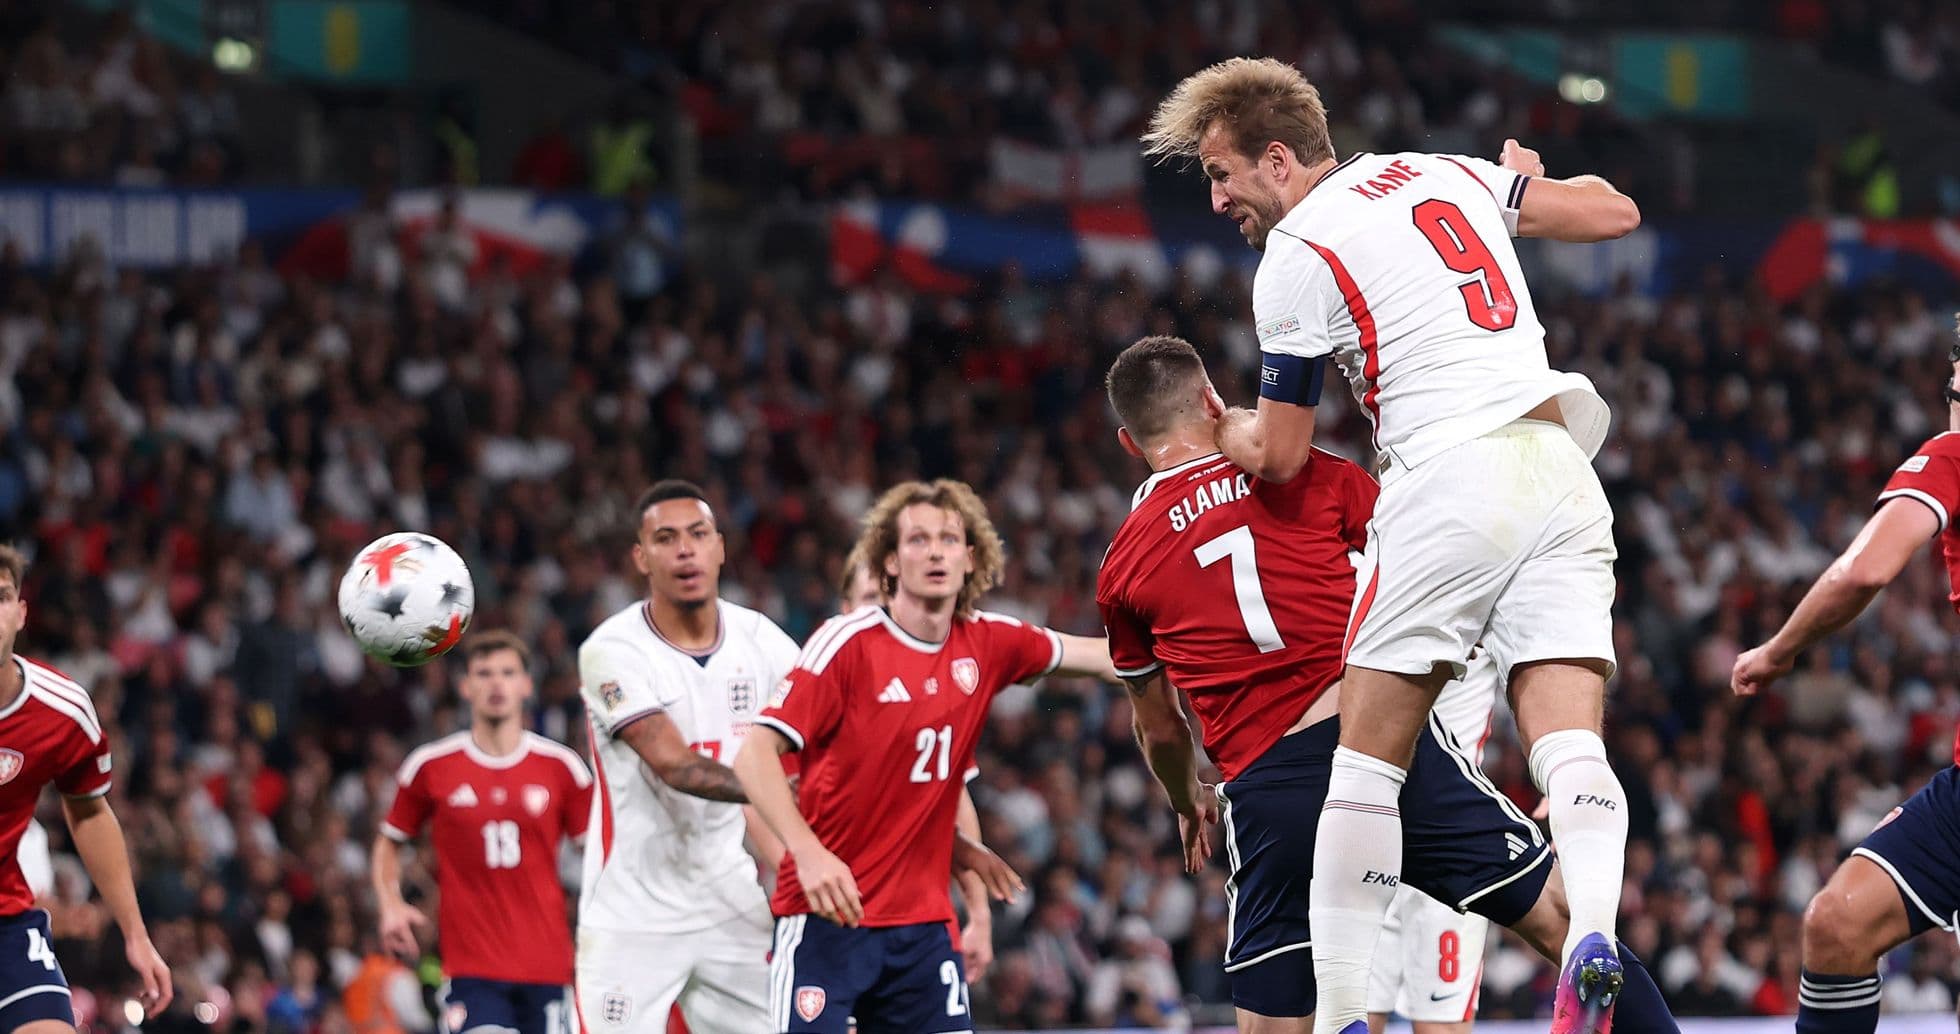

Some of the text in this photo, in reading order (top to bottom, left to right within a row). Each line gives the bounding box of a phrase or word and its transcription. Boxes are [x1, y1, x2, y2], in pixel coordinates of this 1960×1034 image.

[1349, 160, 1422, 200] KANE
[1412, 198, 1518, 332] 9
[1168, 473, 1251, 532] SLAMA
[1193, 524, 1287, 654] 7
[910, 724, 953, 783] 21
[1573, 794, 1617, 811] ENG
[481, 819, 522, 869] 18
[1362, 870, 1399, 888] ENG
[26, 927, 56, 971] 4
[1438, 930, 1460, 983] 8
